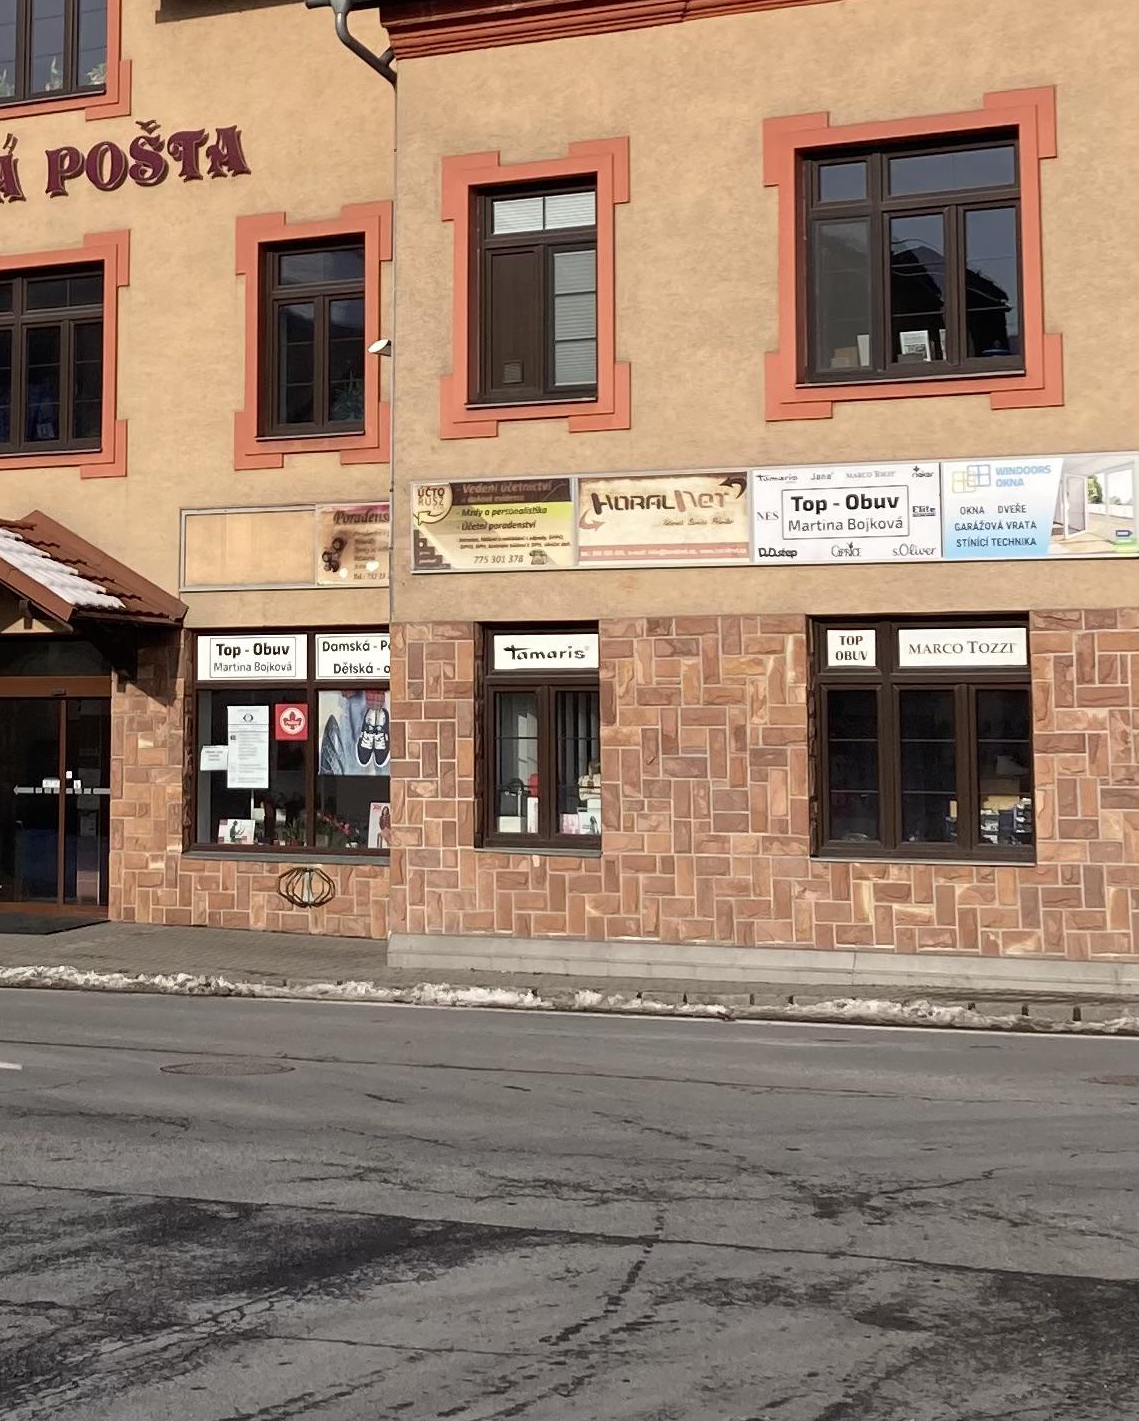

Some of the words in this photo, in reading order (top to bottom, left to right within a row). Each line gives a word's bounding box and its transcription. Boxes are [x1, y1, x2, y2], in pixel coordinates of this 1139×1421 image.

[45, 120, 251, 198] POŠTA
[846, 471, 872, 479] MARCO
[995, 465, 1051, 476] WINDOORS
[995, 479, 1024, 487] OKNA
[418, 485, 445, 498] ÚČTO
[418, 497, 444, 506] RUSZ
[791, 496, 828, 515] Top
[845, 493, 899, 510] Obuv
[462, 508, 483, 518] Mzdy
[491, 506, 547, 517] personalistika
[960, 506, 985, 515] OKNA
[997, 503, 1026, 514] DVEŘE
[333, 507, 390, 525] Poradens
[461, 521, 487, 531] Účetní
[489, 520, 536, 532] poradenství
[788, 520, 843, 532] Martina
[848, 516, 903, 532] Bojková
[954, 520, 1003, 531] GARÁŽOVÁ
[1006, 521, 1037, 530] VRATA
[956, 536, 988, 548] STÍNÍCÍ
[991, 537, 1037, 547] TECHNIKA
[322, 641, 370, 652] Damská
[839, 636, 863, 646] TOP
[216, 644, 241, 658] Top
[253, 642, 290, 656] Obuv
[909, 643, 963, 655] MARCO
[967, 641, 1013, 654] TOZZI
[835, 651, 868, 661] OBUV
[213, 662, 252, 673] Martina
[254, 661, 292, 673] Bojková
[333, 663, 373, 675] Dětská
